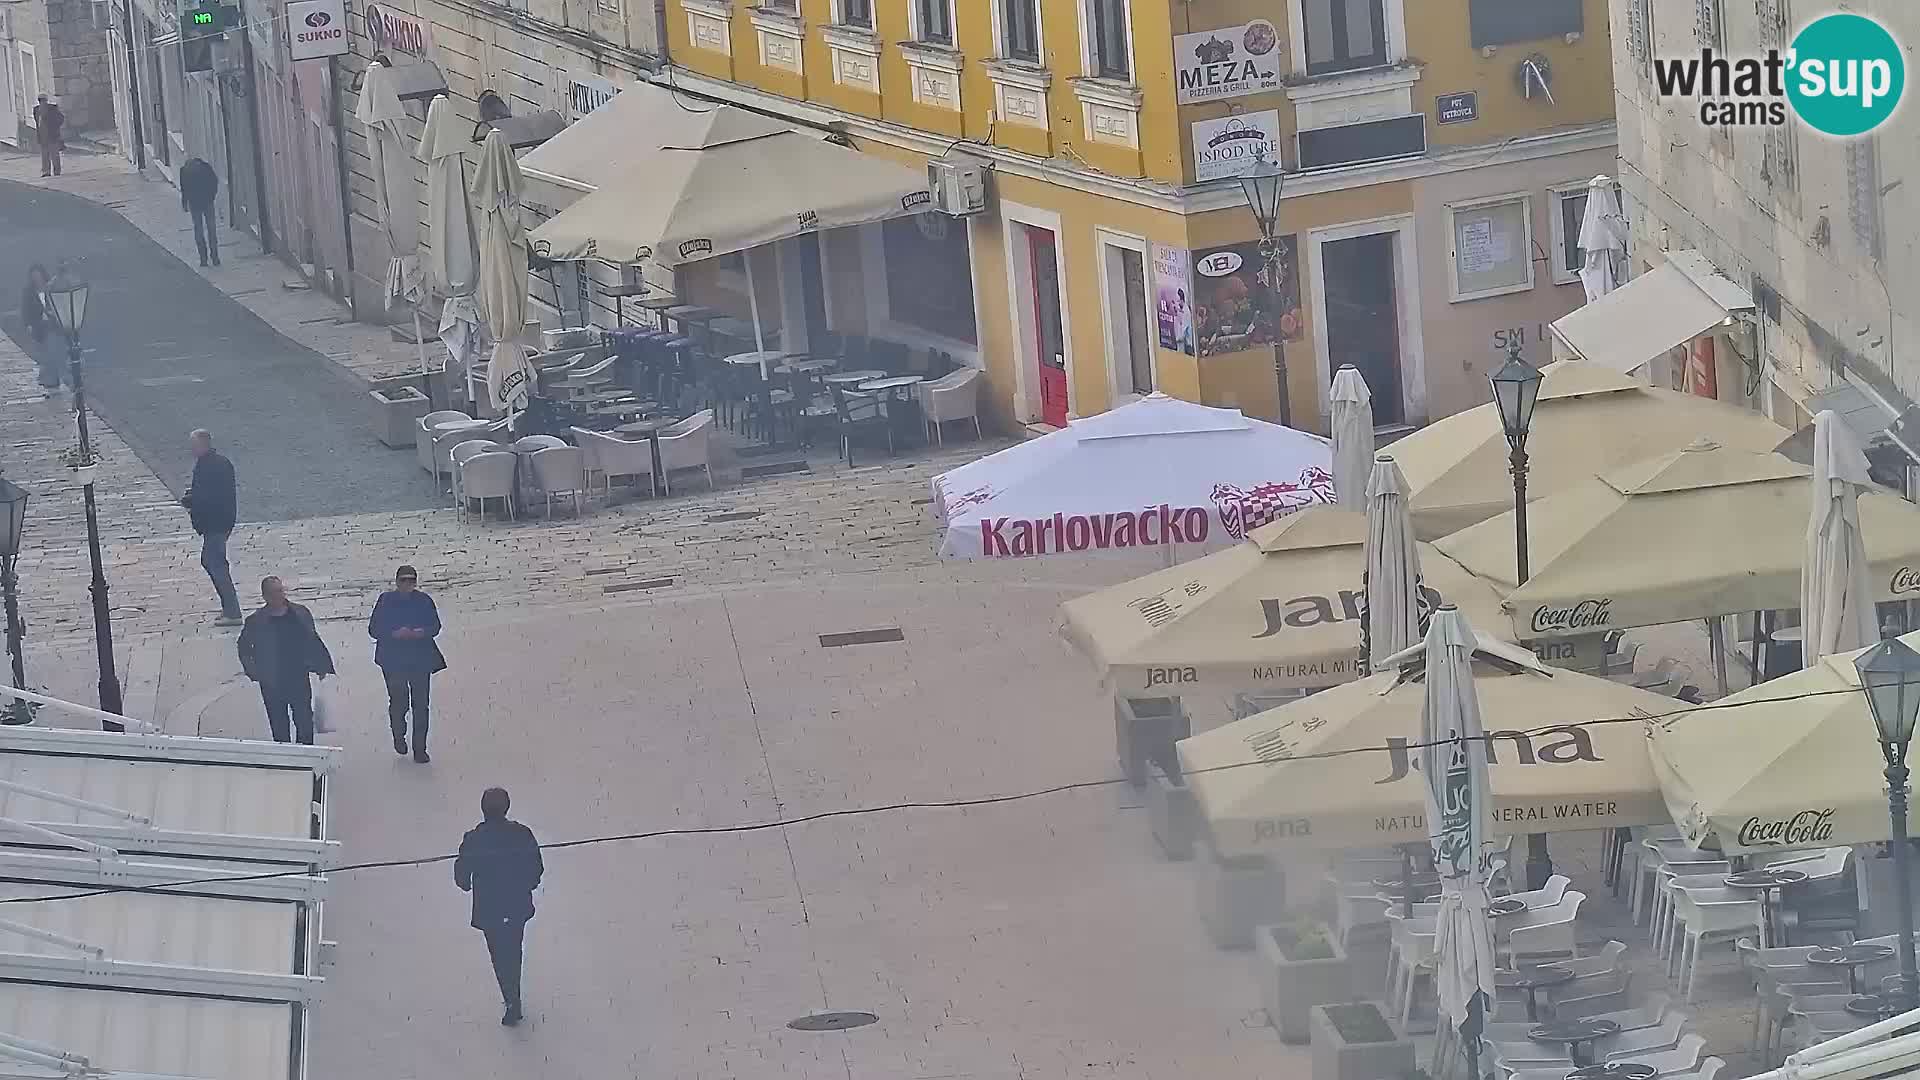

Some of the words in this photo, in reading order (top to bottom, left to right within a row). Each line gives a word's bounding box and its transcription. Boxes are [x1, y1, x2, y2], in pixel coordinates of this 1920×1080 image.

[194, 12, 212, 24] NA
[383, 13, 423, 51] SUKNO
[297, 29, 342, 43] SUKNO
[1180, 59, 1259, 90] MEZA
[1189, 86, 1221, 97] PIZZERIA
[1229, 82, 1249, 92] GRILL
[1198, 145, 1244, 163] ISPOD
[1249, 140, 1277, 155] URE
[980, 503, 1209, 557] Karlovačko
[1531, 598, 1613, 633] Coca-Cola
[1253, 662, 1327, 680] NATURAL
[1374, 814, 1423, 832] NATU
[1553, 801, 1618, 819] WATER
[1737, 807, 1837, 847] Coca-Cola
